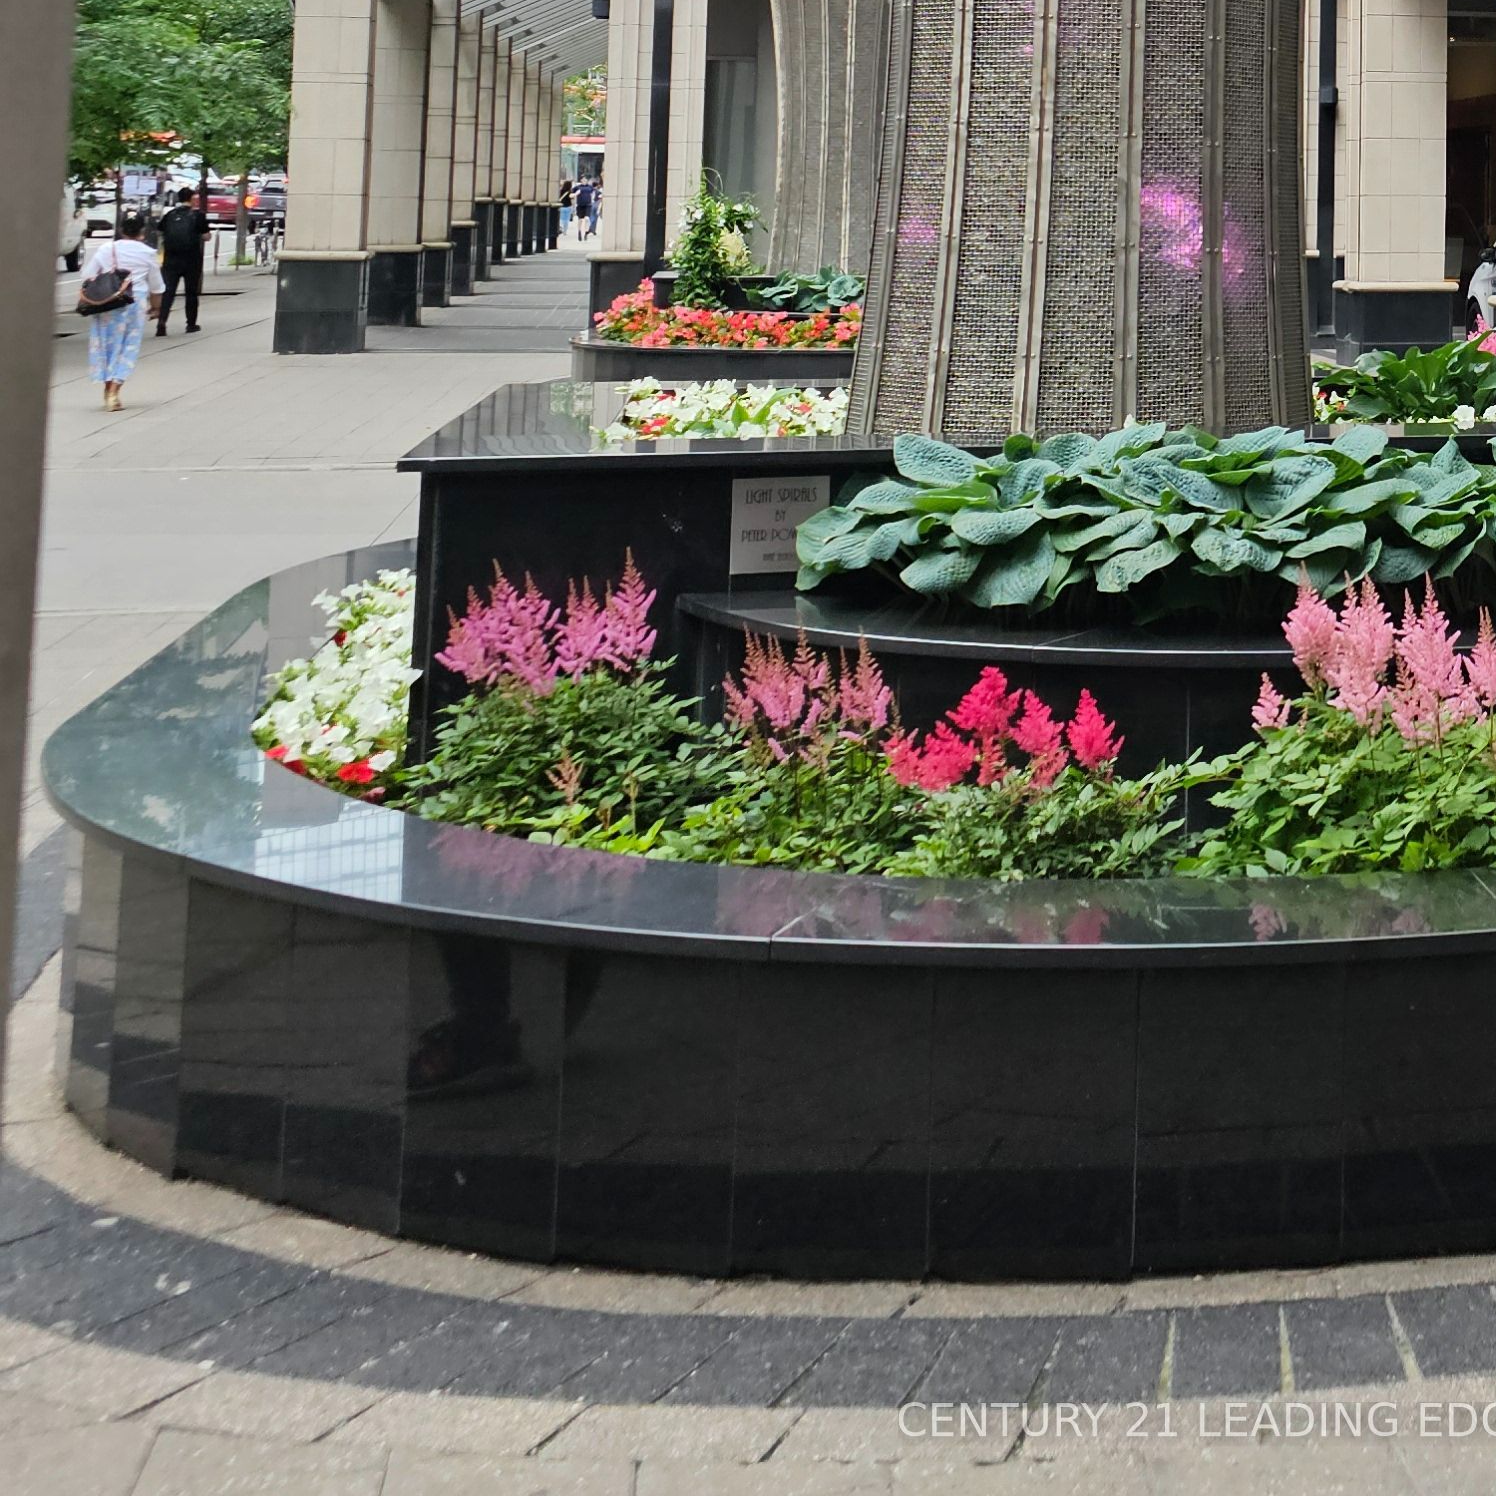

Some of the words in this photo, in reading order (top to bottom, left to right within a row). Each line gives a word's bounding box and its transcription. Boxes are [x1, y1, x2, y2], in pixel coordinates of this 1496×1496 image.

[745, 488, 773, 505] LIGHT
[777, 486, 817, 503] SPIRALS
[775, 509, 786, 522] BY
[741, 529, 767, 543] PETER
